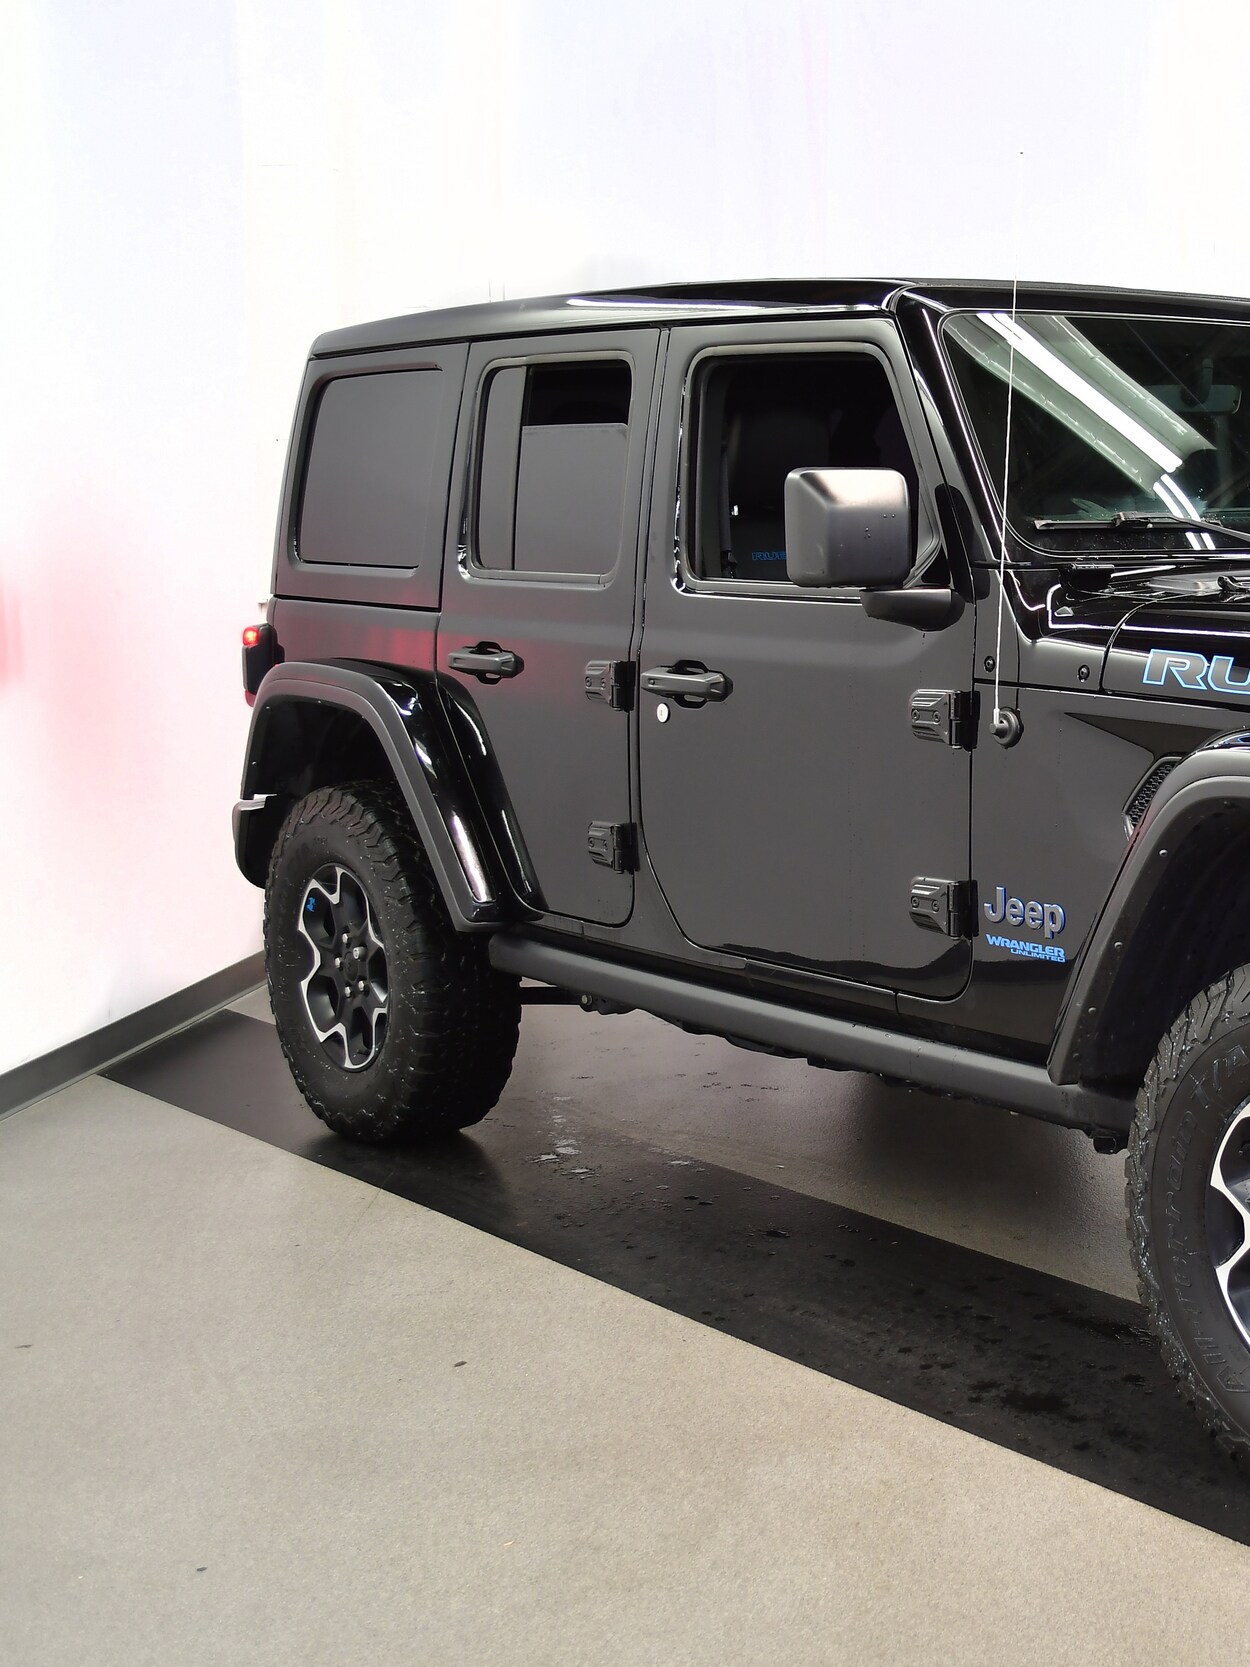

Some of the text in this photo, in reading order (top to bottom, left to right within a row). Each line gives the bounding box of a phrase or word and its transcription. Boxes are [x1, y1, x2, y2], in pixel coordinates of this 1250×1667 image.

[984, 886, 1066, 939] Jeep
[986, 933, 1065, 957] WRANGLER
[1011, 948, 1066, 963] UNLIMITED
